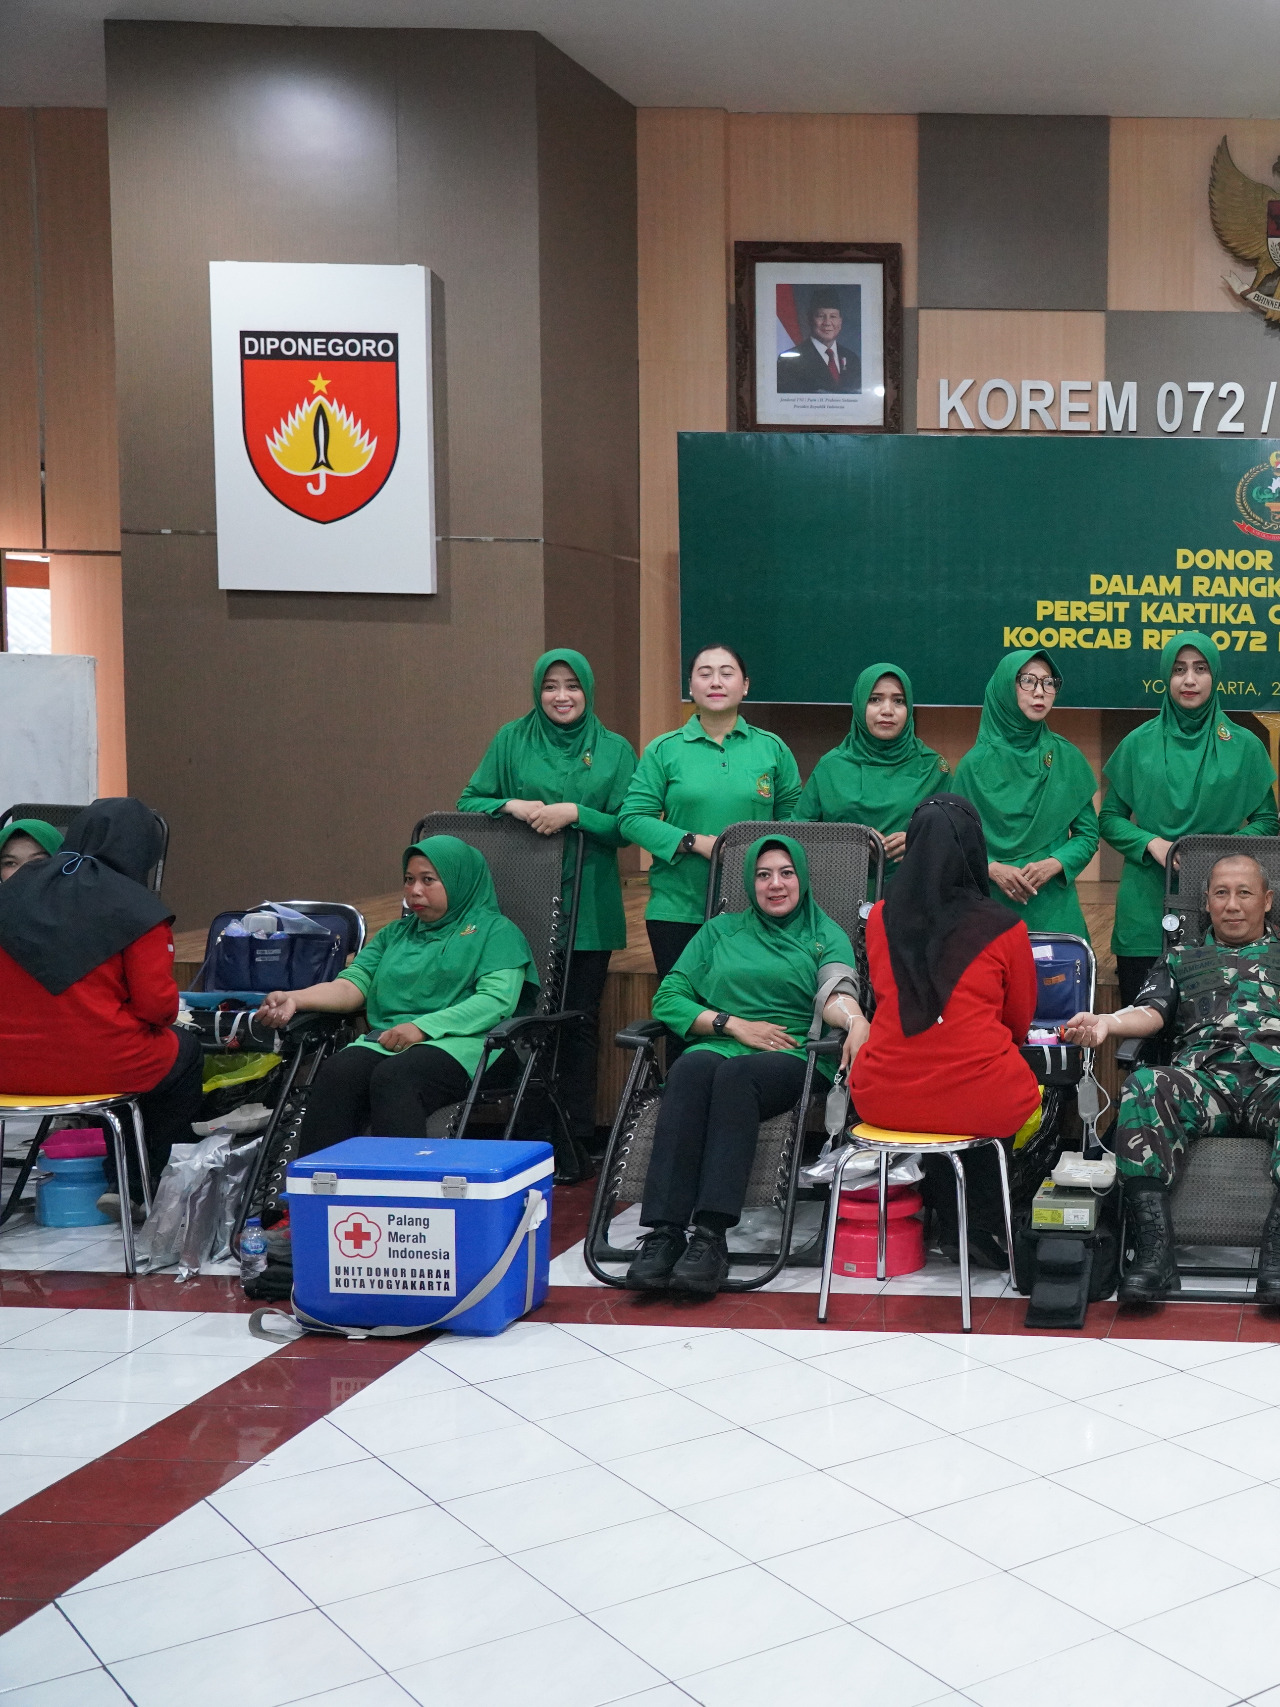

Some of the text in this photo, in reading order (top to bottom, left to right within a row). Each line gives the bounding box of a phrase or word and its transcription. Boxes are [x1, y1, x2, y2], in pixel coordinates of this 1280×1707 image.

[244, 337, 394, 357] DIPONEGORO
[938, 378, 1138, 433] KOREM
[1156, 381, 1246, 433] 072
[1260, 381, 1278, 434] /
[1176, 548, 1273, 571] DONOR
[1090, 574, 1181, 596] DALAM
[1036, 600, 1129, 623] PERSIT
[1141, 602, 1256, 625] KARTIKA
[1003, 626, 1132, 650] KOORCAB
[1142, 628, 1199, 650] RE
[1211, 630, 1268, 652] 072
[1142, 679, 1261, 697] YOARTA,
[388, 1214, 430, 1229] Palang
[388, 1231, 427, 1243] Merah
[388, 1247, 450, 1260] Indonesia
[335, 1265, 450, 1279] UNIT DONOR DARAH
[335, 1278, 450, 1292] KOTA YOGYAKARTA
